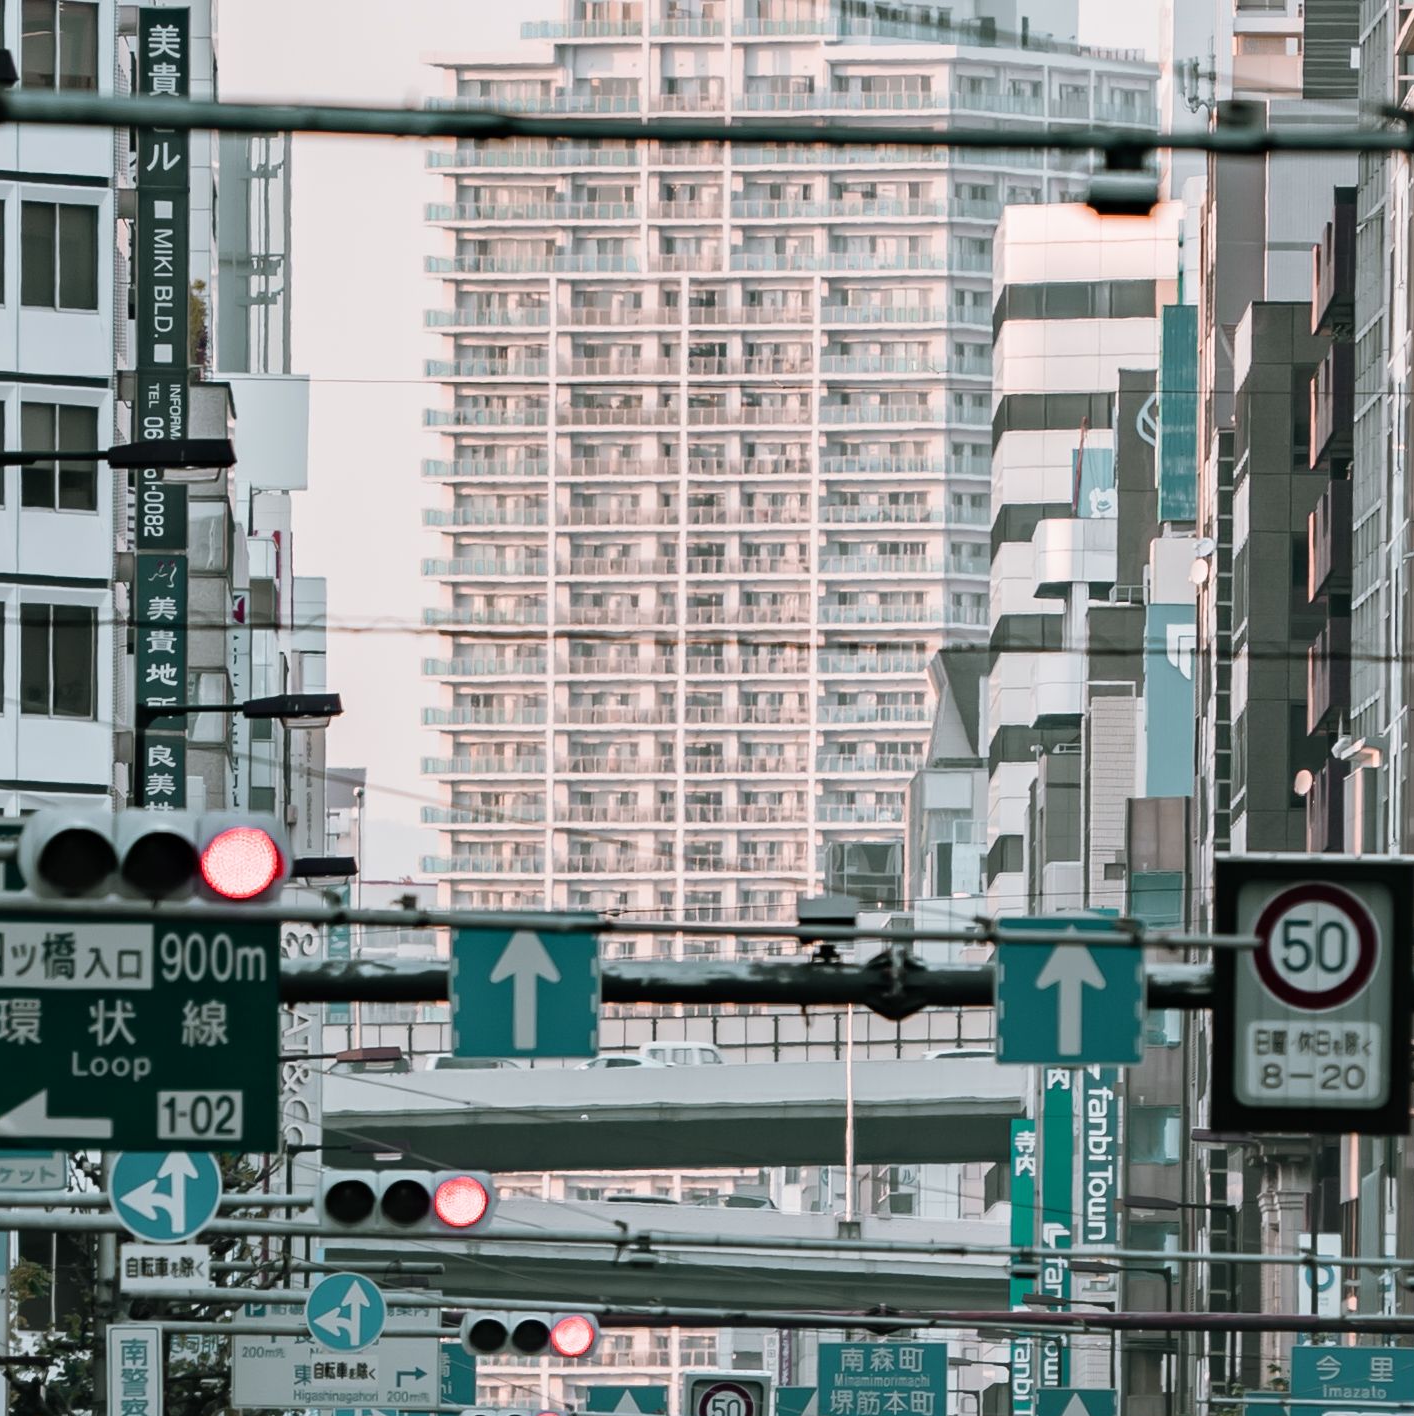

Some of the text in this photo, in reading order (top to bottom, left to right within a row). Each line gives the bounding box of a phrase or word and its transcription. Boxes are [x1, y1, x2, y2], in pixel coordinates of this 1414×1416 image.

[146, 25, 181, 173] 美貴ル
[154, 228, 174, 339] MIKI BLD.
[148, 383, 160, 408] TEL
[160, 932, 267, 983] 900m
[1281, 919, 1348, 974] 50
[72, 1050, 152, 1083] Loop
[161, 1095, 236, 1136] 1-02
[1088, 1085, 1113, 1241] fanbi Town
[125, 1256, 206, 1281] 自転車を除く
[313, 1361, 377, 1382] 自転車を除く
[840, 1346, 925, 1373] 南森町
[1315, 1355, 1394, 1383] 今里
[833, 1373, 931, 1388] Minamimorimachi
[829, 1390, 936, 1416] 堺筋本町
